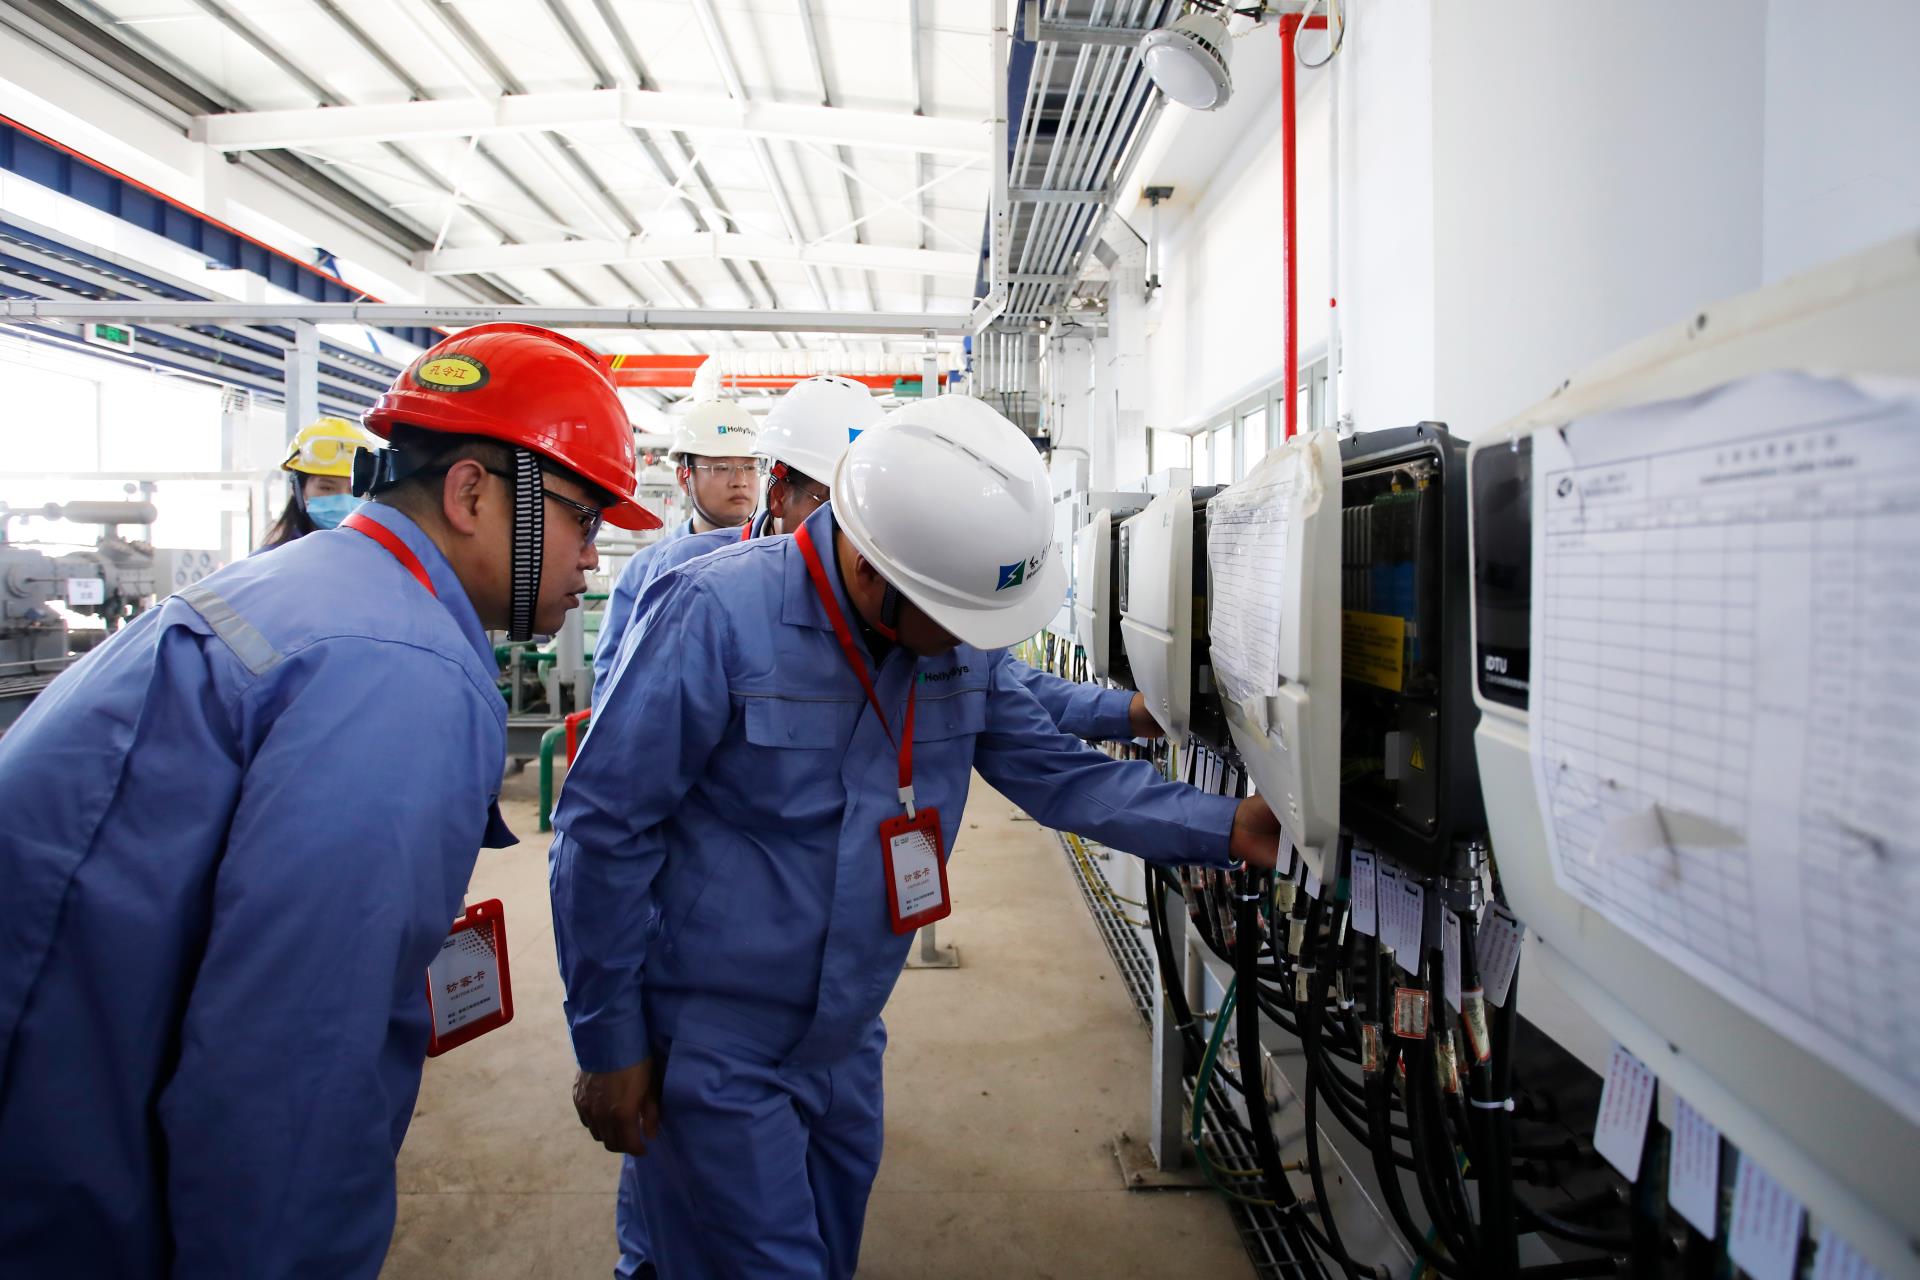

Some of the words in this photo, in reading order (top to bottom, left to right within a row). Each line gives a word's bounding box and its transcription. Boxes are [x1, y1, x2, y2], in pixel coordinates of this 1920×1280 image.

[925, 665, 969, 683] HollySys
[446, 970, 486, 993] 访客卡
